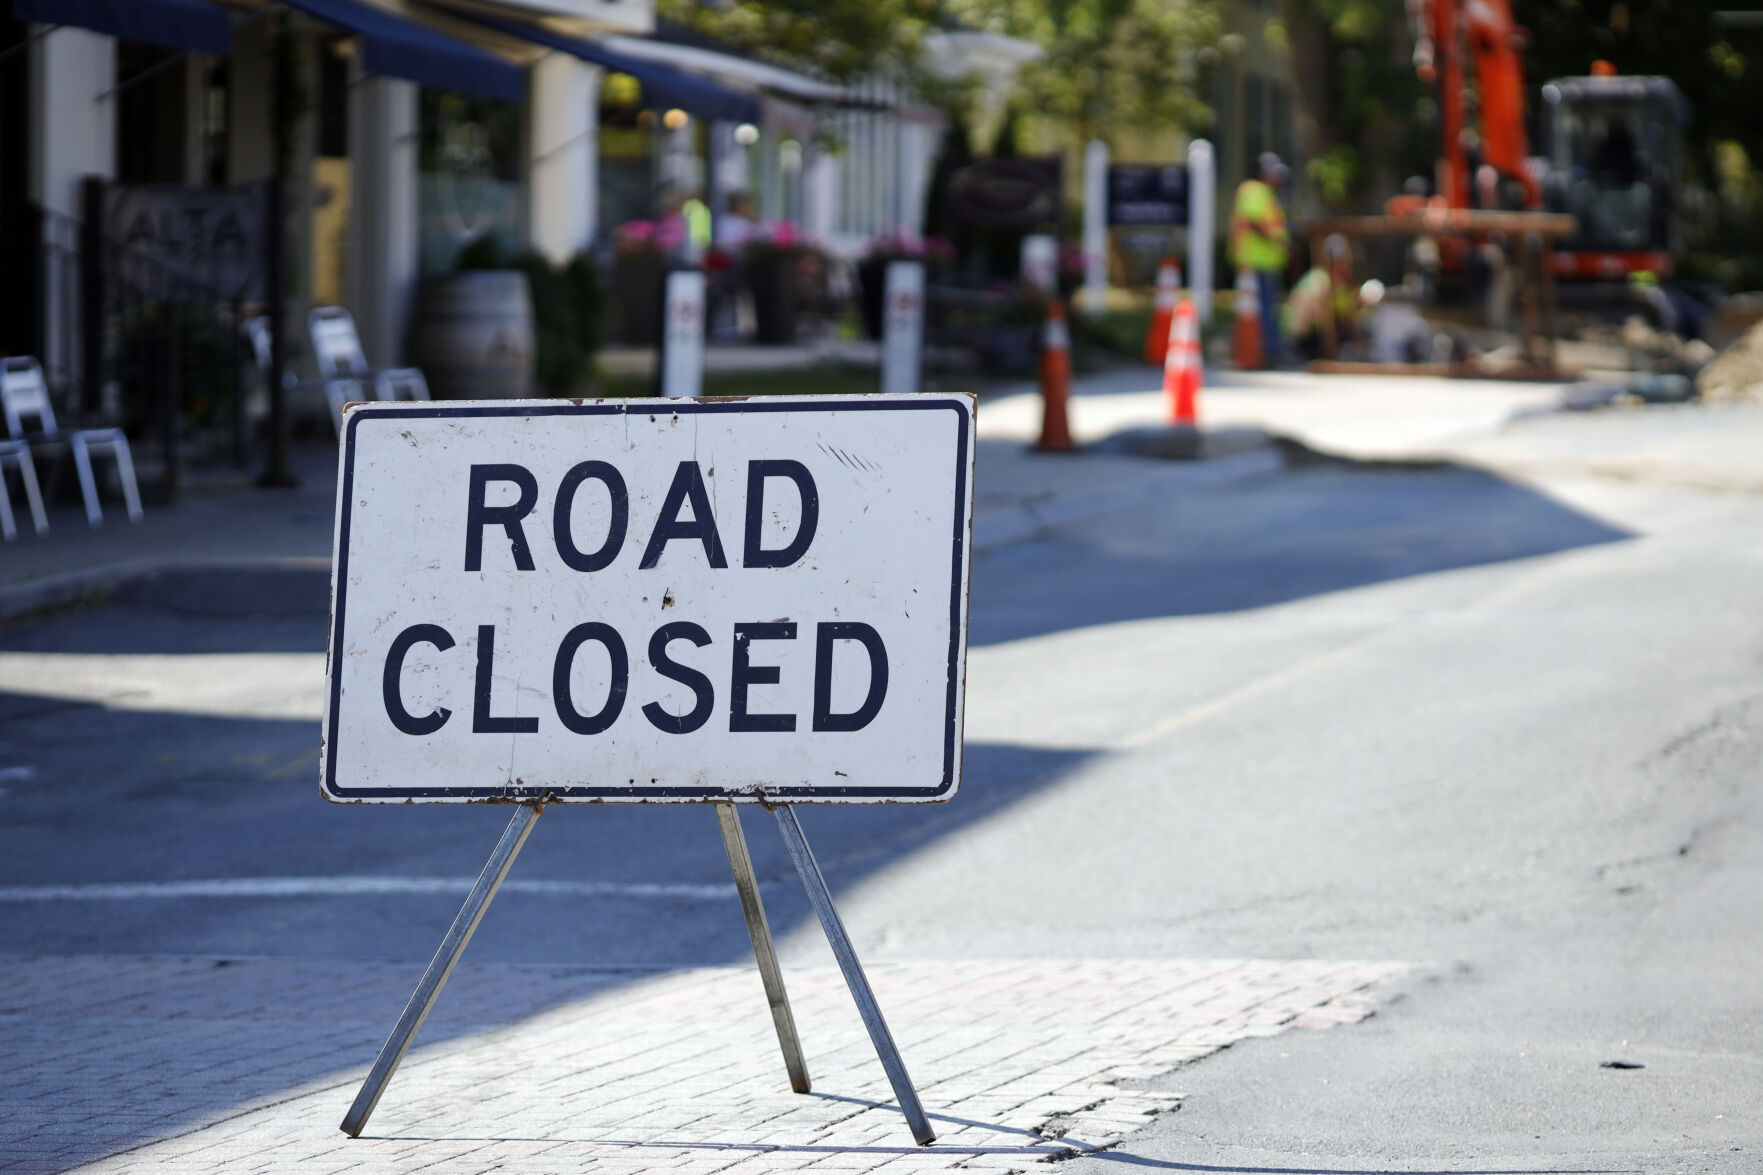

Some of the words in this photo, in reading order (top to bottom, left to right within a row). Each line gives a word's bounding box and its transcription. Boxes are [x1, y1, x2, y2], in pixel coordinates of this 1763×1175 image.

[126, 207, 247, 256] ALTA
[464, 460, 820, 573] ROAD
[382, 621, 890, 737] CLOSED
